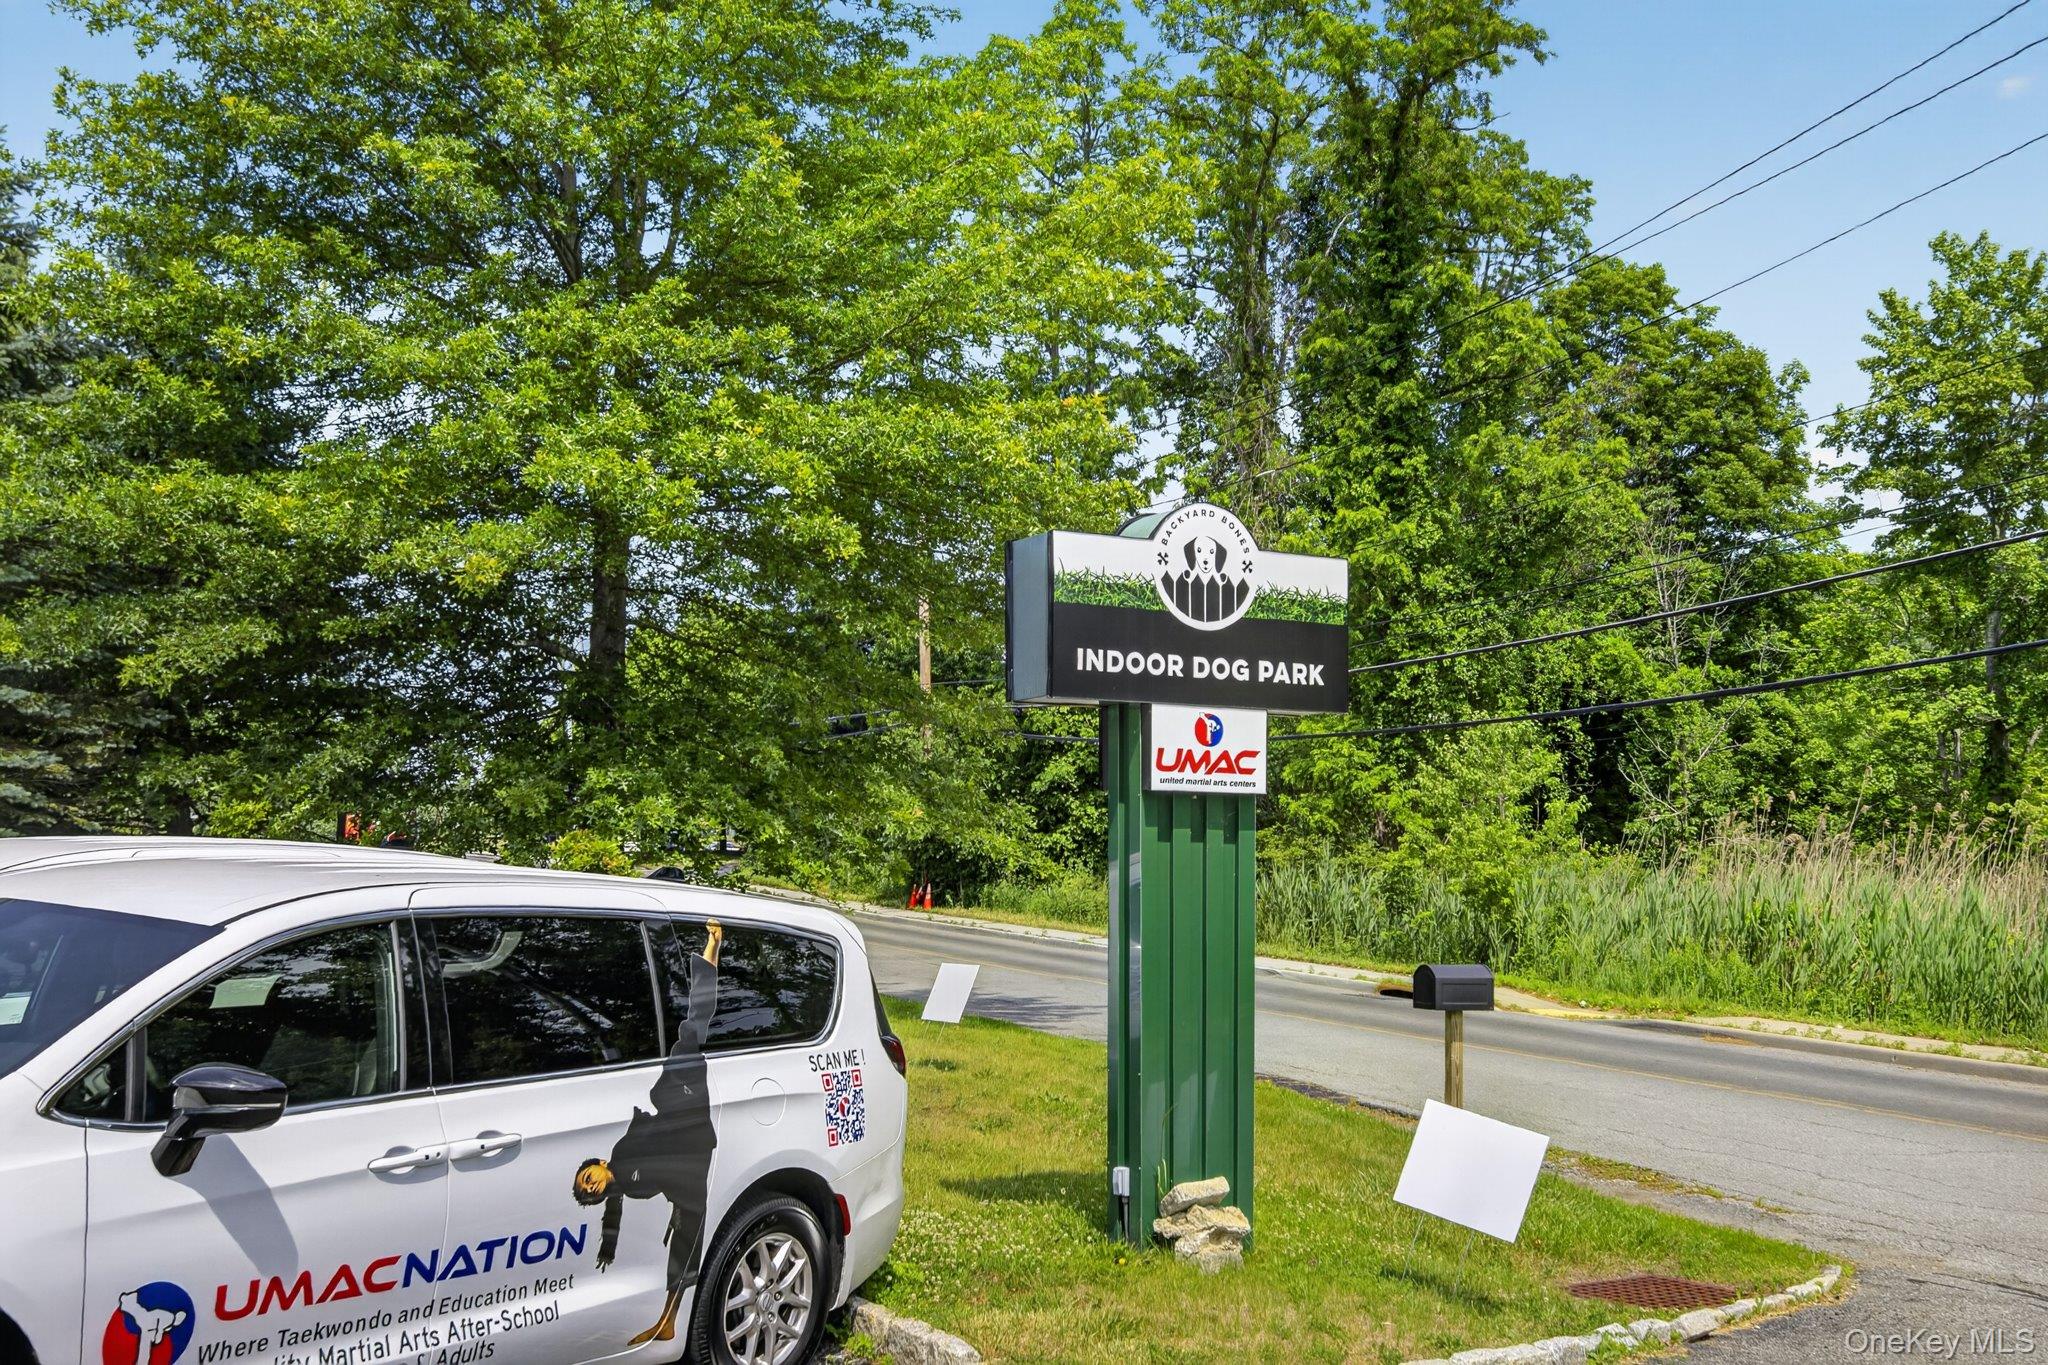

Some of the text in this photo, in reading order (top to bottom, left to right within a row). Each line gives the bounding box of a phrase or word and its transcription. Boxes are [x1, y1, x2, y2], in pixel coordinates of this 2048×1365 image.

[1161, 509, 1250, 554] BACKYARD BONES
[1077, 648, 1325, 686] INDOOR DOG PARK
[1156, 748, 1260, 775] UMAC
[1160, 777, 1184, 785] united
[1186, 778, 1212, 786] martial
[1229, 780, 1256, 788] centers
[809, 1052, 841, 1072] SCAN
[199, 1336, 269, 1365] Where
[278, 1310, 392, 1348] Taekwondo
[398, 1300, 435, 1324] and
[438, 1284, 527, 1316] Education
[534, 1274, 574, 1297] Meet
[319, 1300, 560, 1365] Martial Arts After-School
[437, 1339, 495, 1365] Adults
